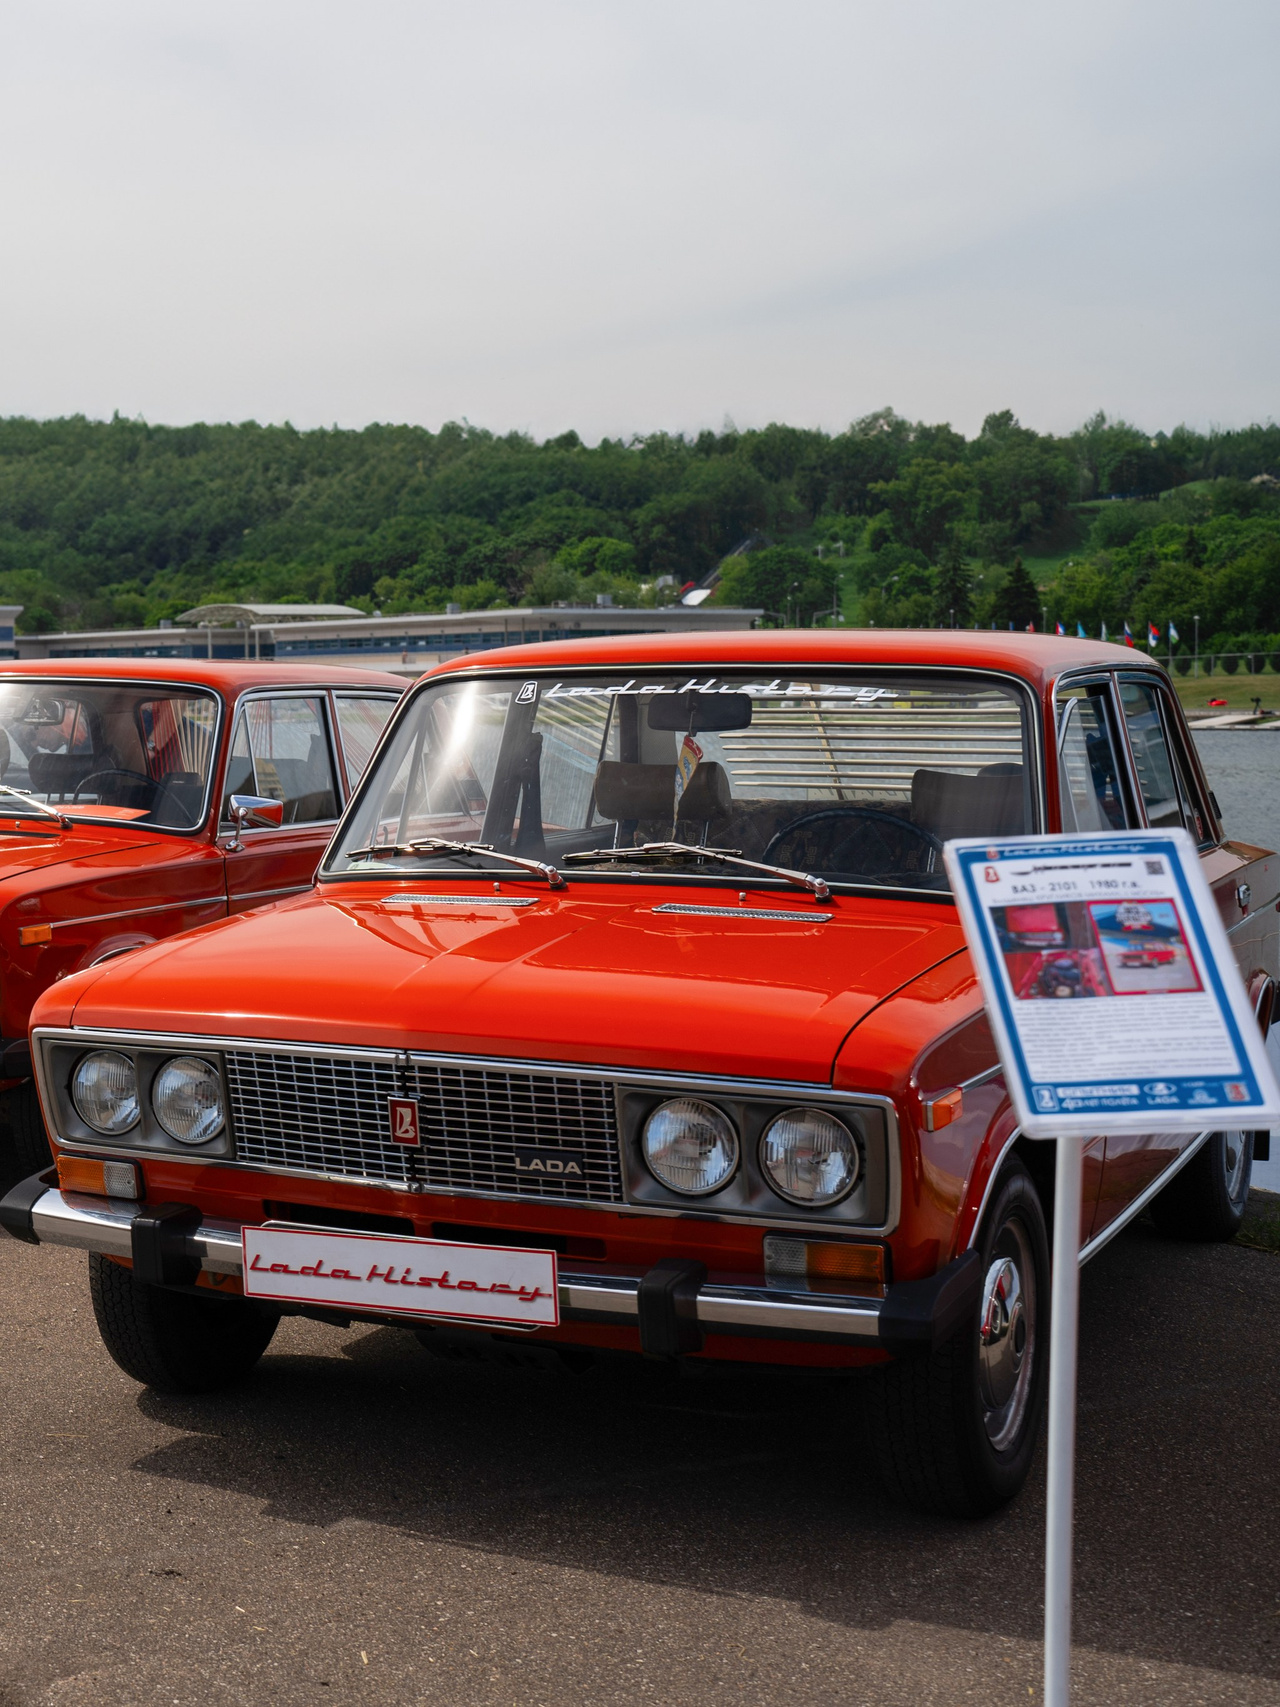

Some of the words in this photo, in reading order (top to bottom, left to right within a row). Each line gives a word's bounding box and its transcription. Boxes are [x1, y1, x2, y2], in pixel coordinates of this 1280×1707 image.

[545, 680, 677, 698] Lada
[677, 679, 900, 702] History
[1004, 847, 1059, 857] Lada
[1049, 882, 1078, 892] 2101
[1089, 879, 1119, 889] 1980
[515, 1157, 583, 1175] LADA
[249, 1254, 362, 1281] Lada
[365, 1263, 553, 1302] History
